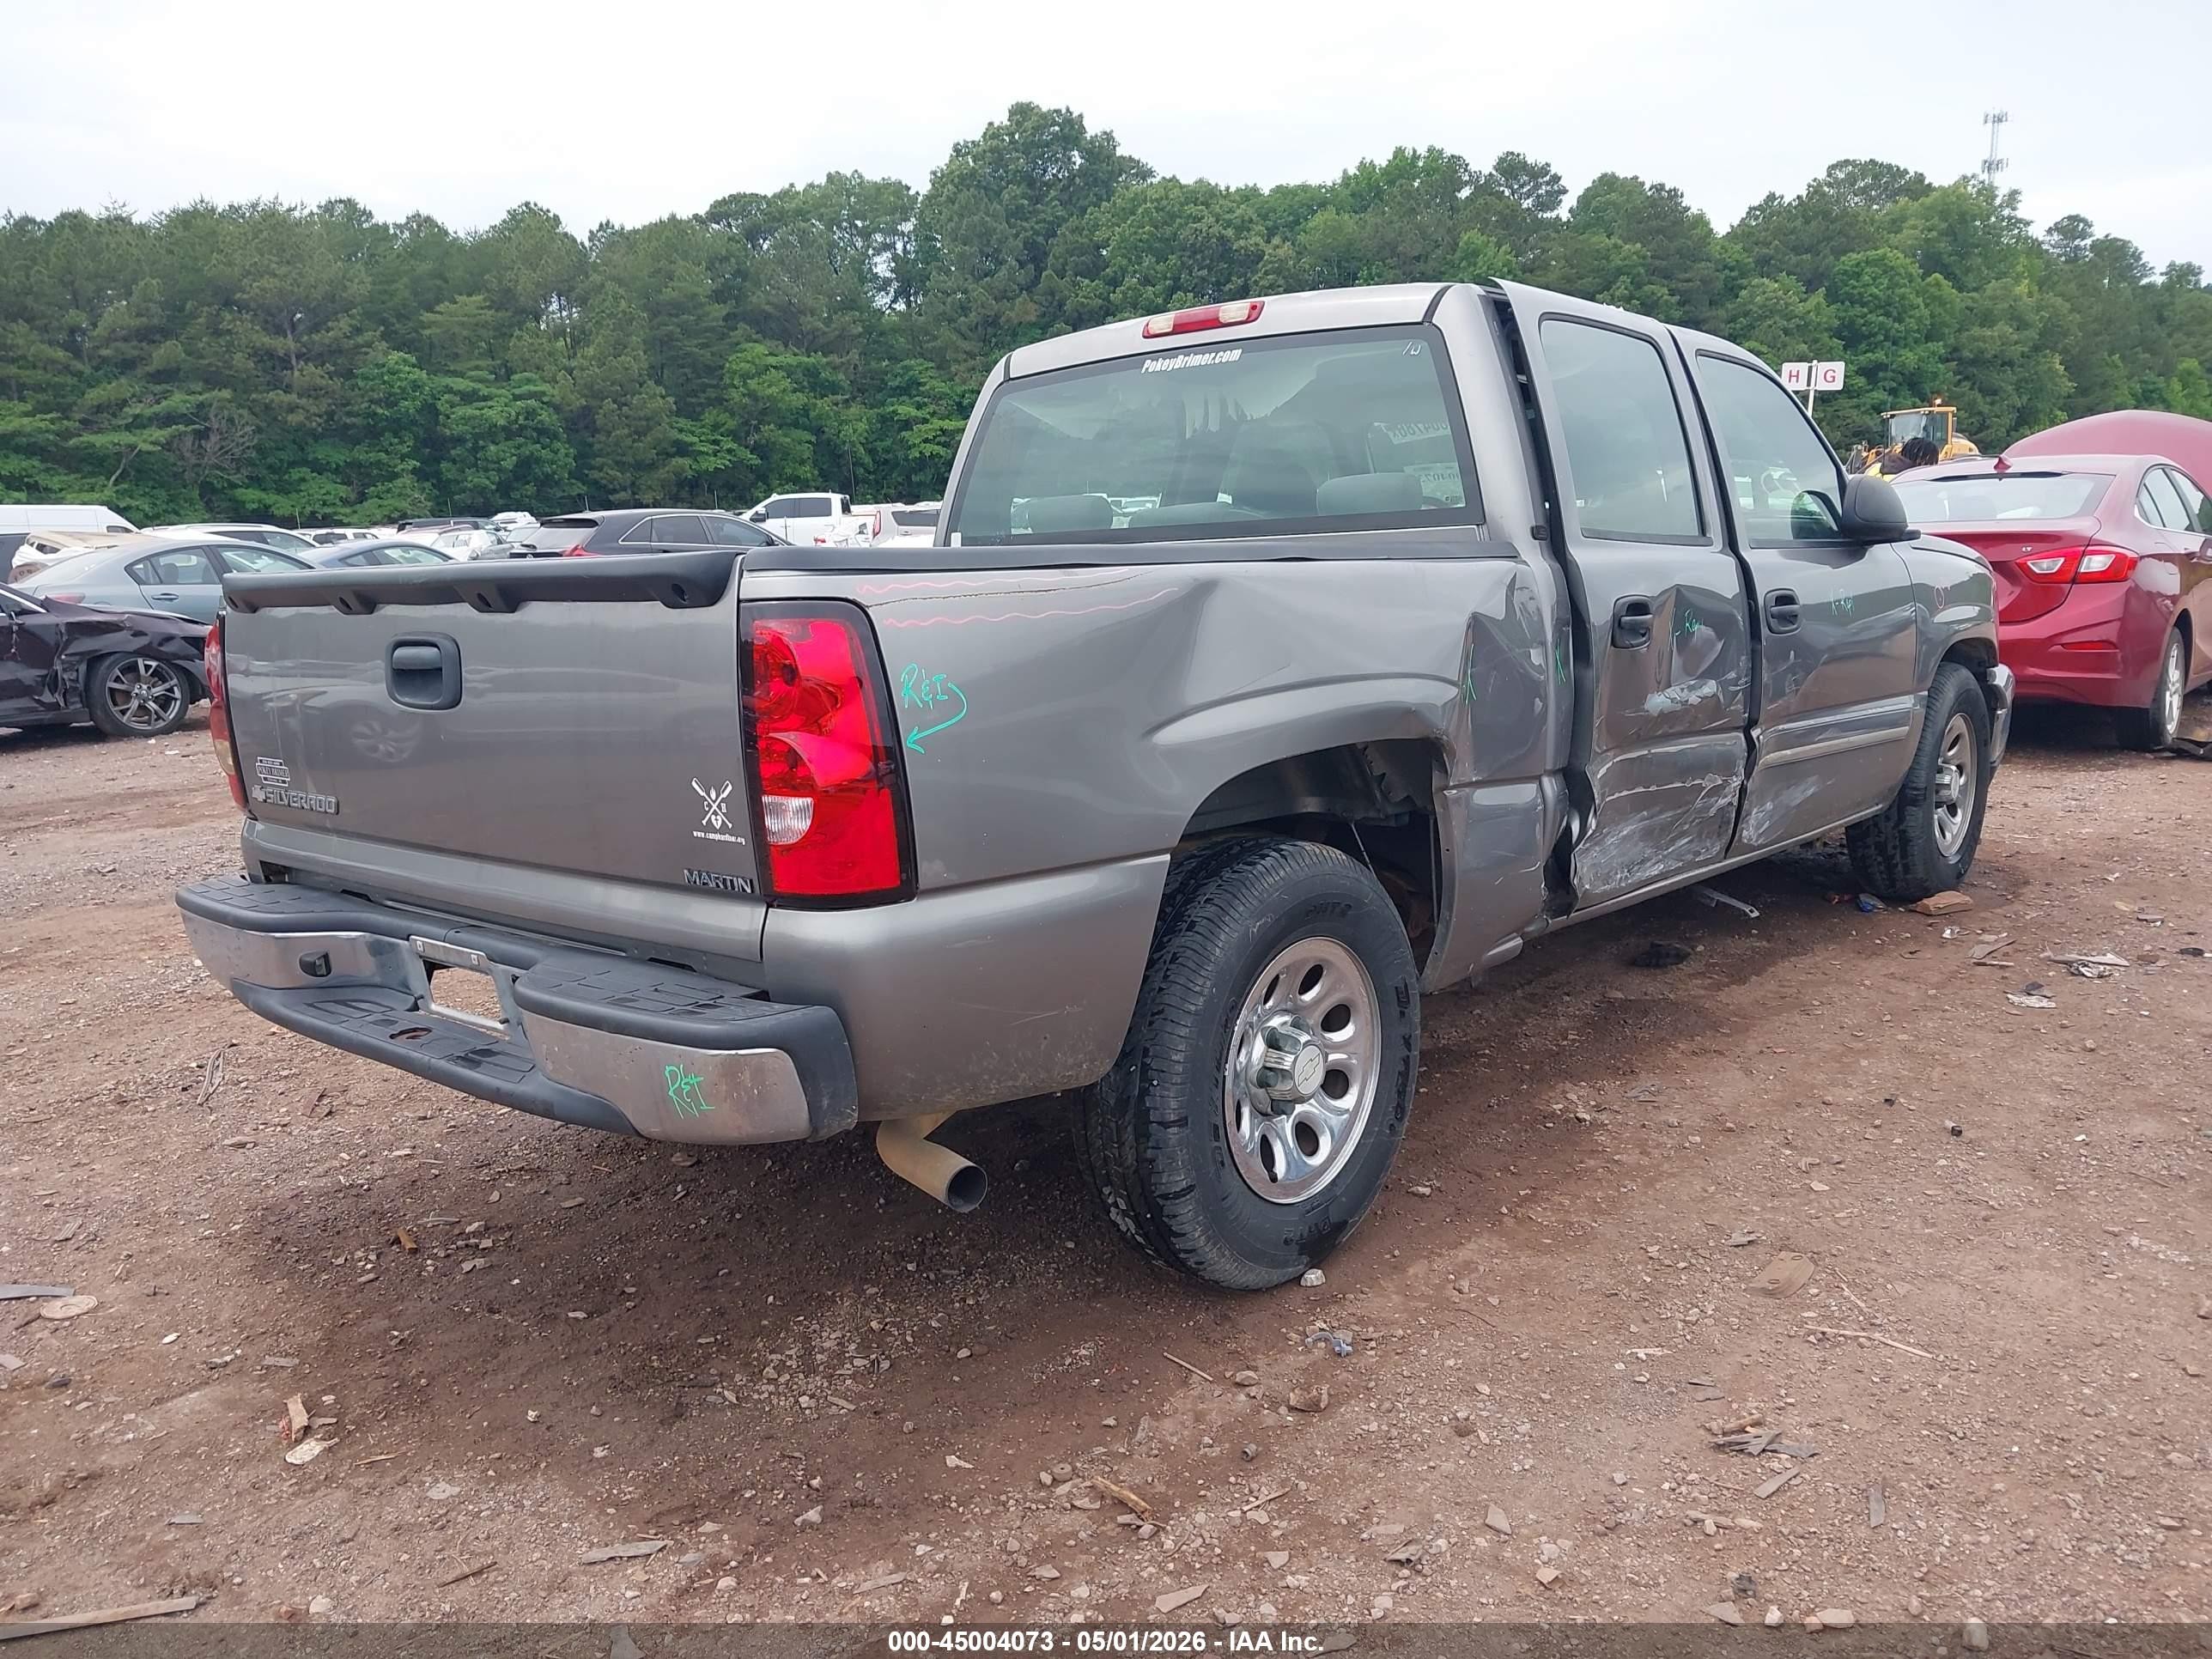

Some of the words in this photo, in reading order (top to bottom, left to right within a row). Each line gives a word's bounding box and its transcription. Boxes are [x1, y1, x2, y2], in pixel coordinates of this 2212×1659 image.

[1141, 349, 1243, 374] PokeyBrimer.com
[1788, 369, 1800, 383] H
[1824, 368, 1837, 383] G
[264, 787, 338, 815] SILVERADO
[704, 801, 709, 811] C
[720, 803, 727, 813] H
[683, 868, 753, 894] MARTIN
